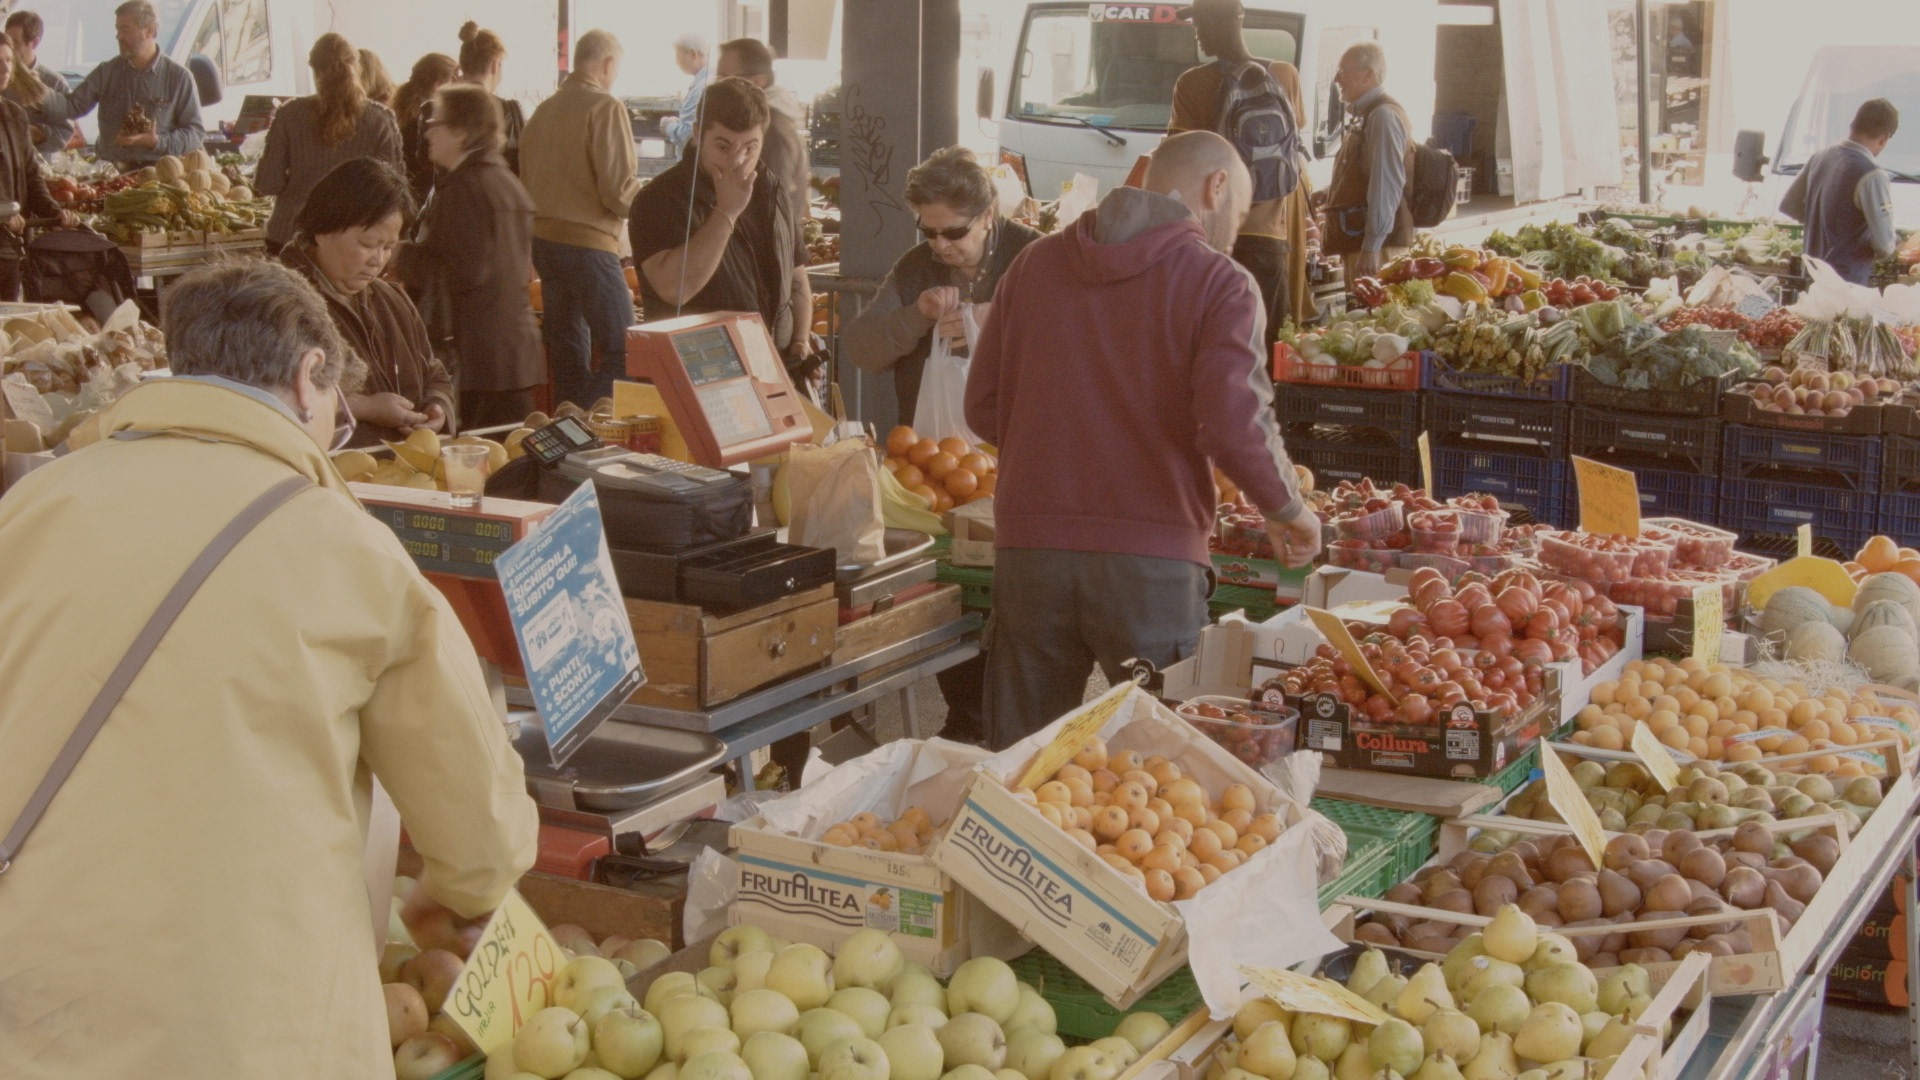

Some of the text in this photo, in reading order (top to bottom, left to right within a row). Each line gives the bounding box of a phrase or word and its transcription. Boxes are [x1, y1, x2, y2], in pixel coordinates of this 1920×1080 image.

[1105, 7, 1150, 20] CAR
[512, 544, 572, 603] RICHIEDILA
[516, 576, 555, 617] SUBITO
[556, 554, 578, 581] QUI!
[548, 655, 580, 692] PUNTI
[553, 662, 592, 706] SCONTI
[1356, 732, 1428, 753] Collura
[960, 815, 1073, 914] FRUTALTEA
[741, 870, 860, 912] FRUTALTEA
[454, 905, 516, 1018] GOLDEN
